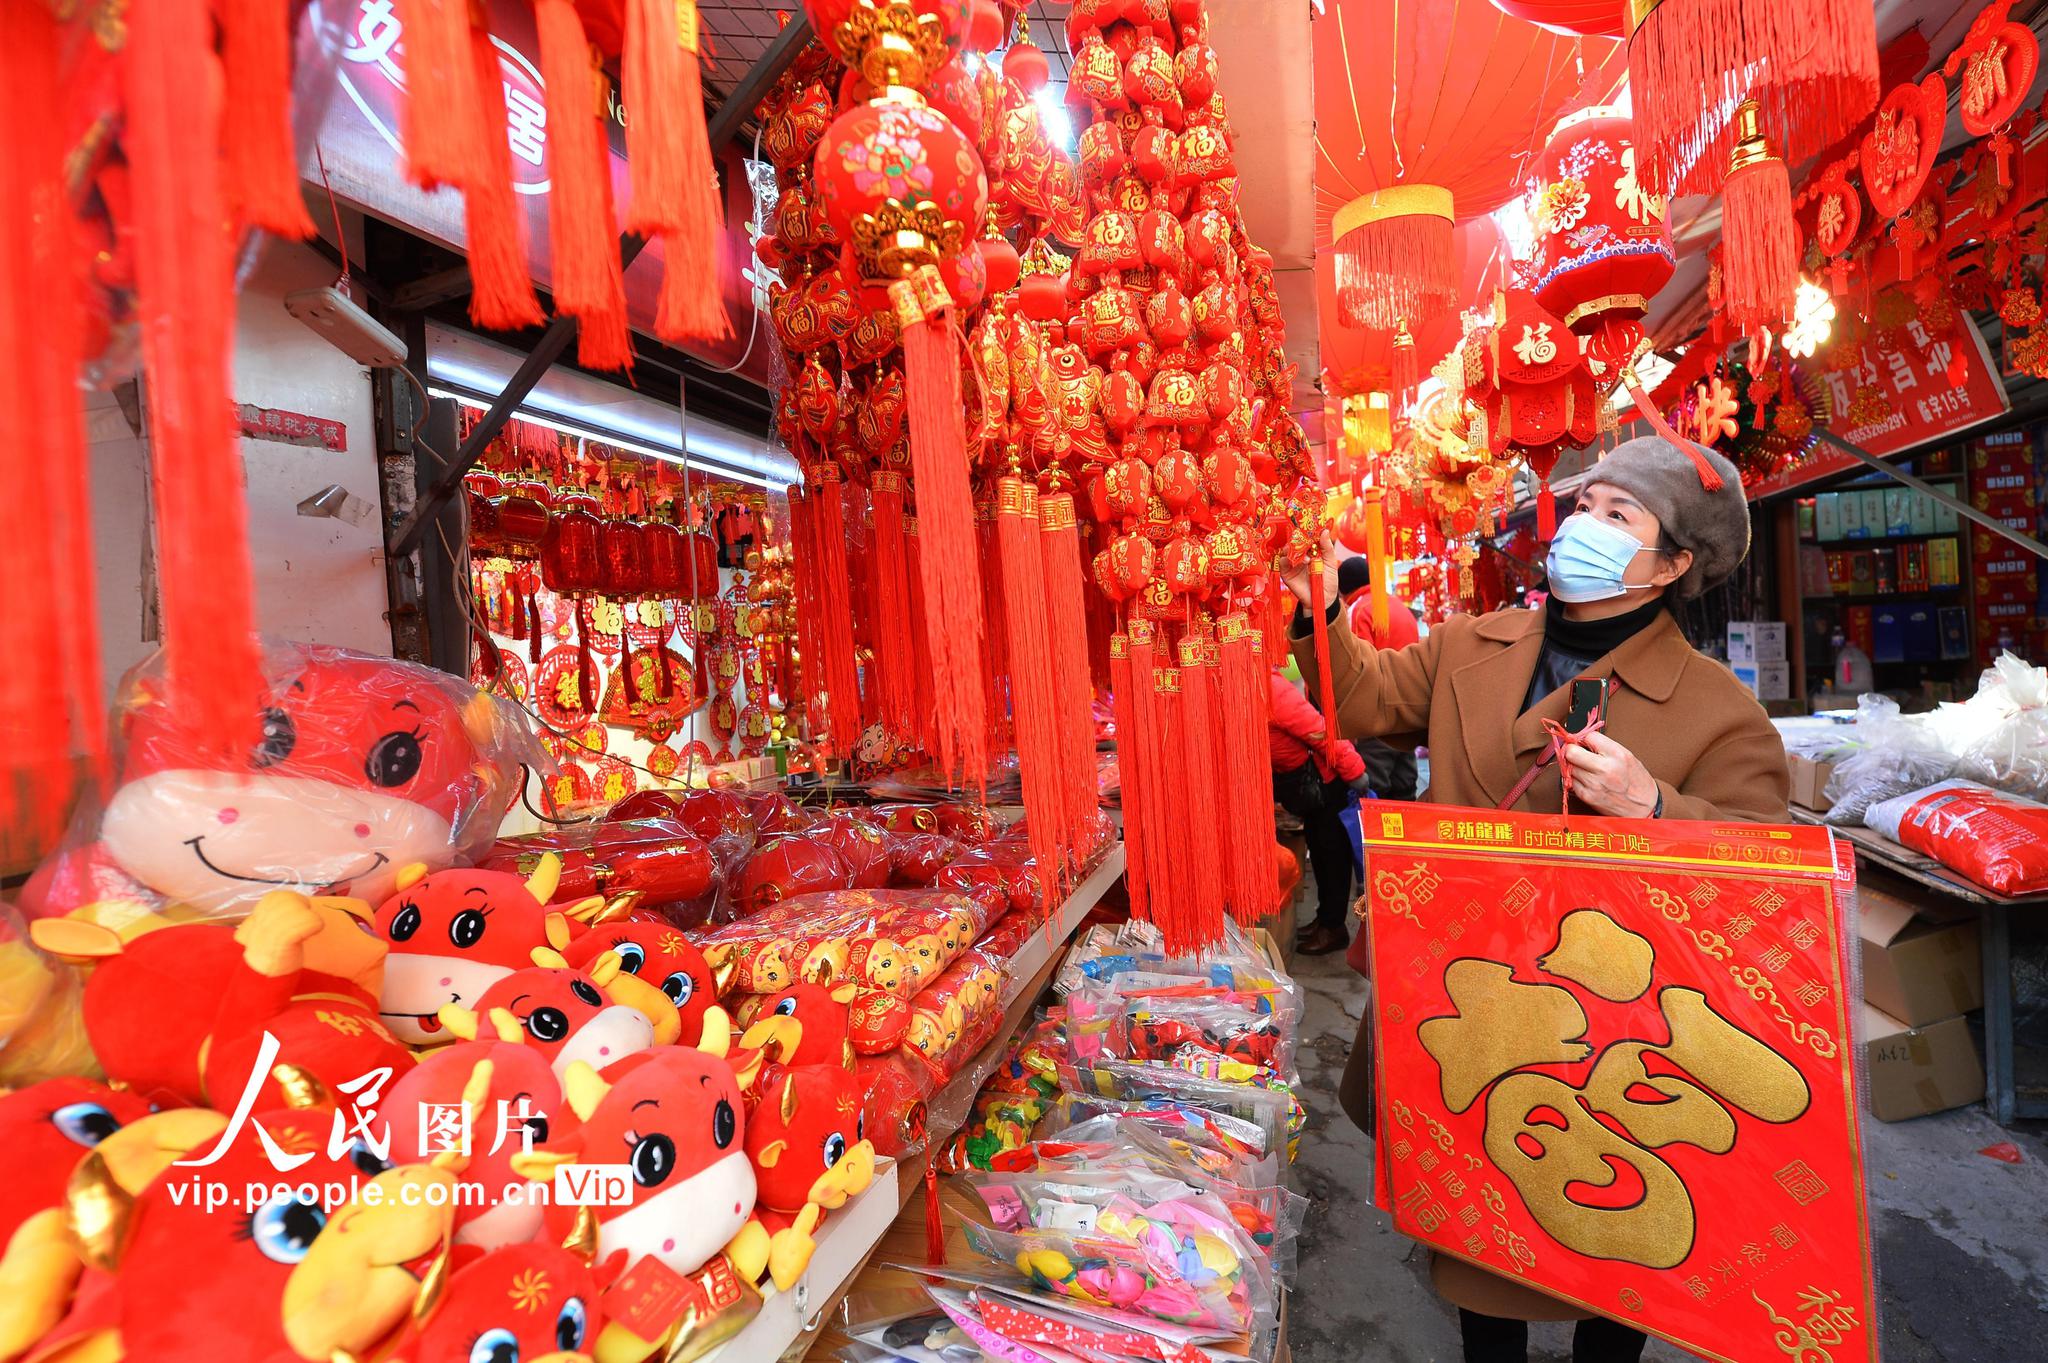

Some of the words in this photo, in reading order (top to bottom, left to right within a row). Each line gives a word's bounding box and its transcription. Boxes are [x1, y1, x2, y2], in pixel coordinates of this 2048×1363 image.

[1184, 126, 1216, 158] 福
[1120, 179, 1150, 212] 福
[1092, 213, 1125, 245] 福
[1512, 322, 1557, 365] 福
[1164, 376, 1195, 406] 福
[1693, 377, 1740, 447] 快
[1144, 577, 1174, 606] 福
[1456, 821, 1514, 840] 新龍飛
[1525, 830, 1651, 853] 时尚精美门贴
[1403, 862, 1443, 905] 福
[1750, 886, 1787, 917] 福
[1787, 917, 1823, 951] 福
[1759, 943, 1793, 974] 福
[1417, 908, 1812, 1269] 福
[1400, 1179, 1451, 1233] 福
[1796, 1284, 1861, 1346] 福
